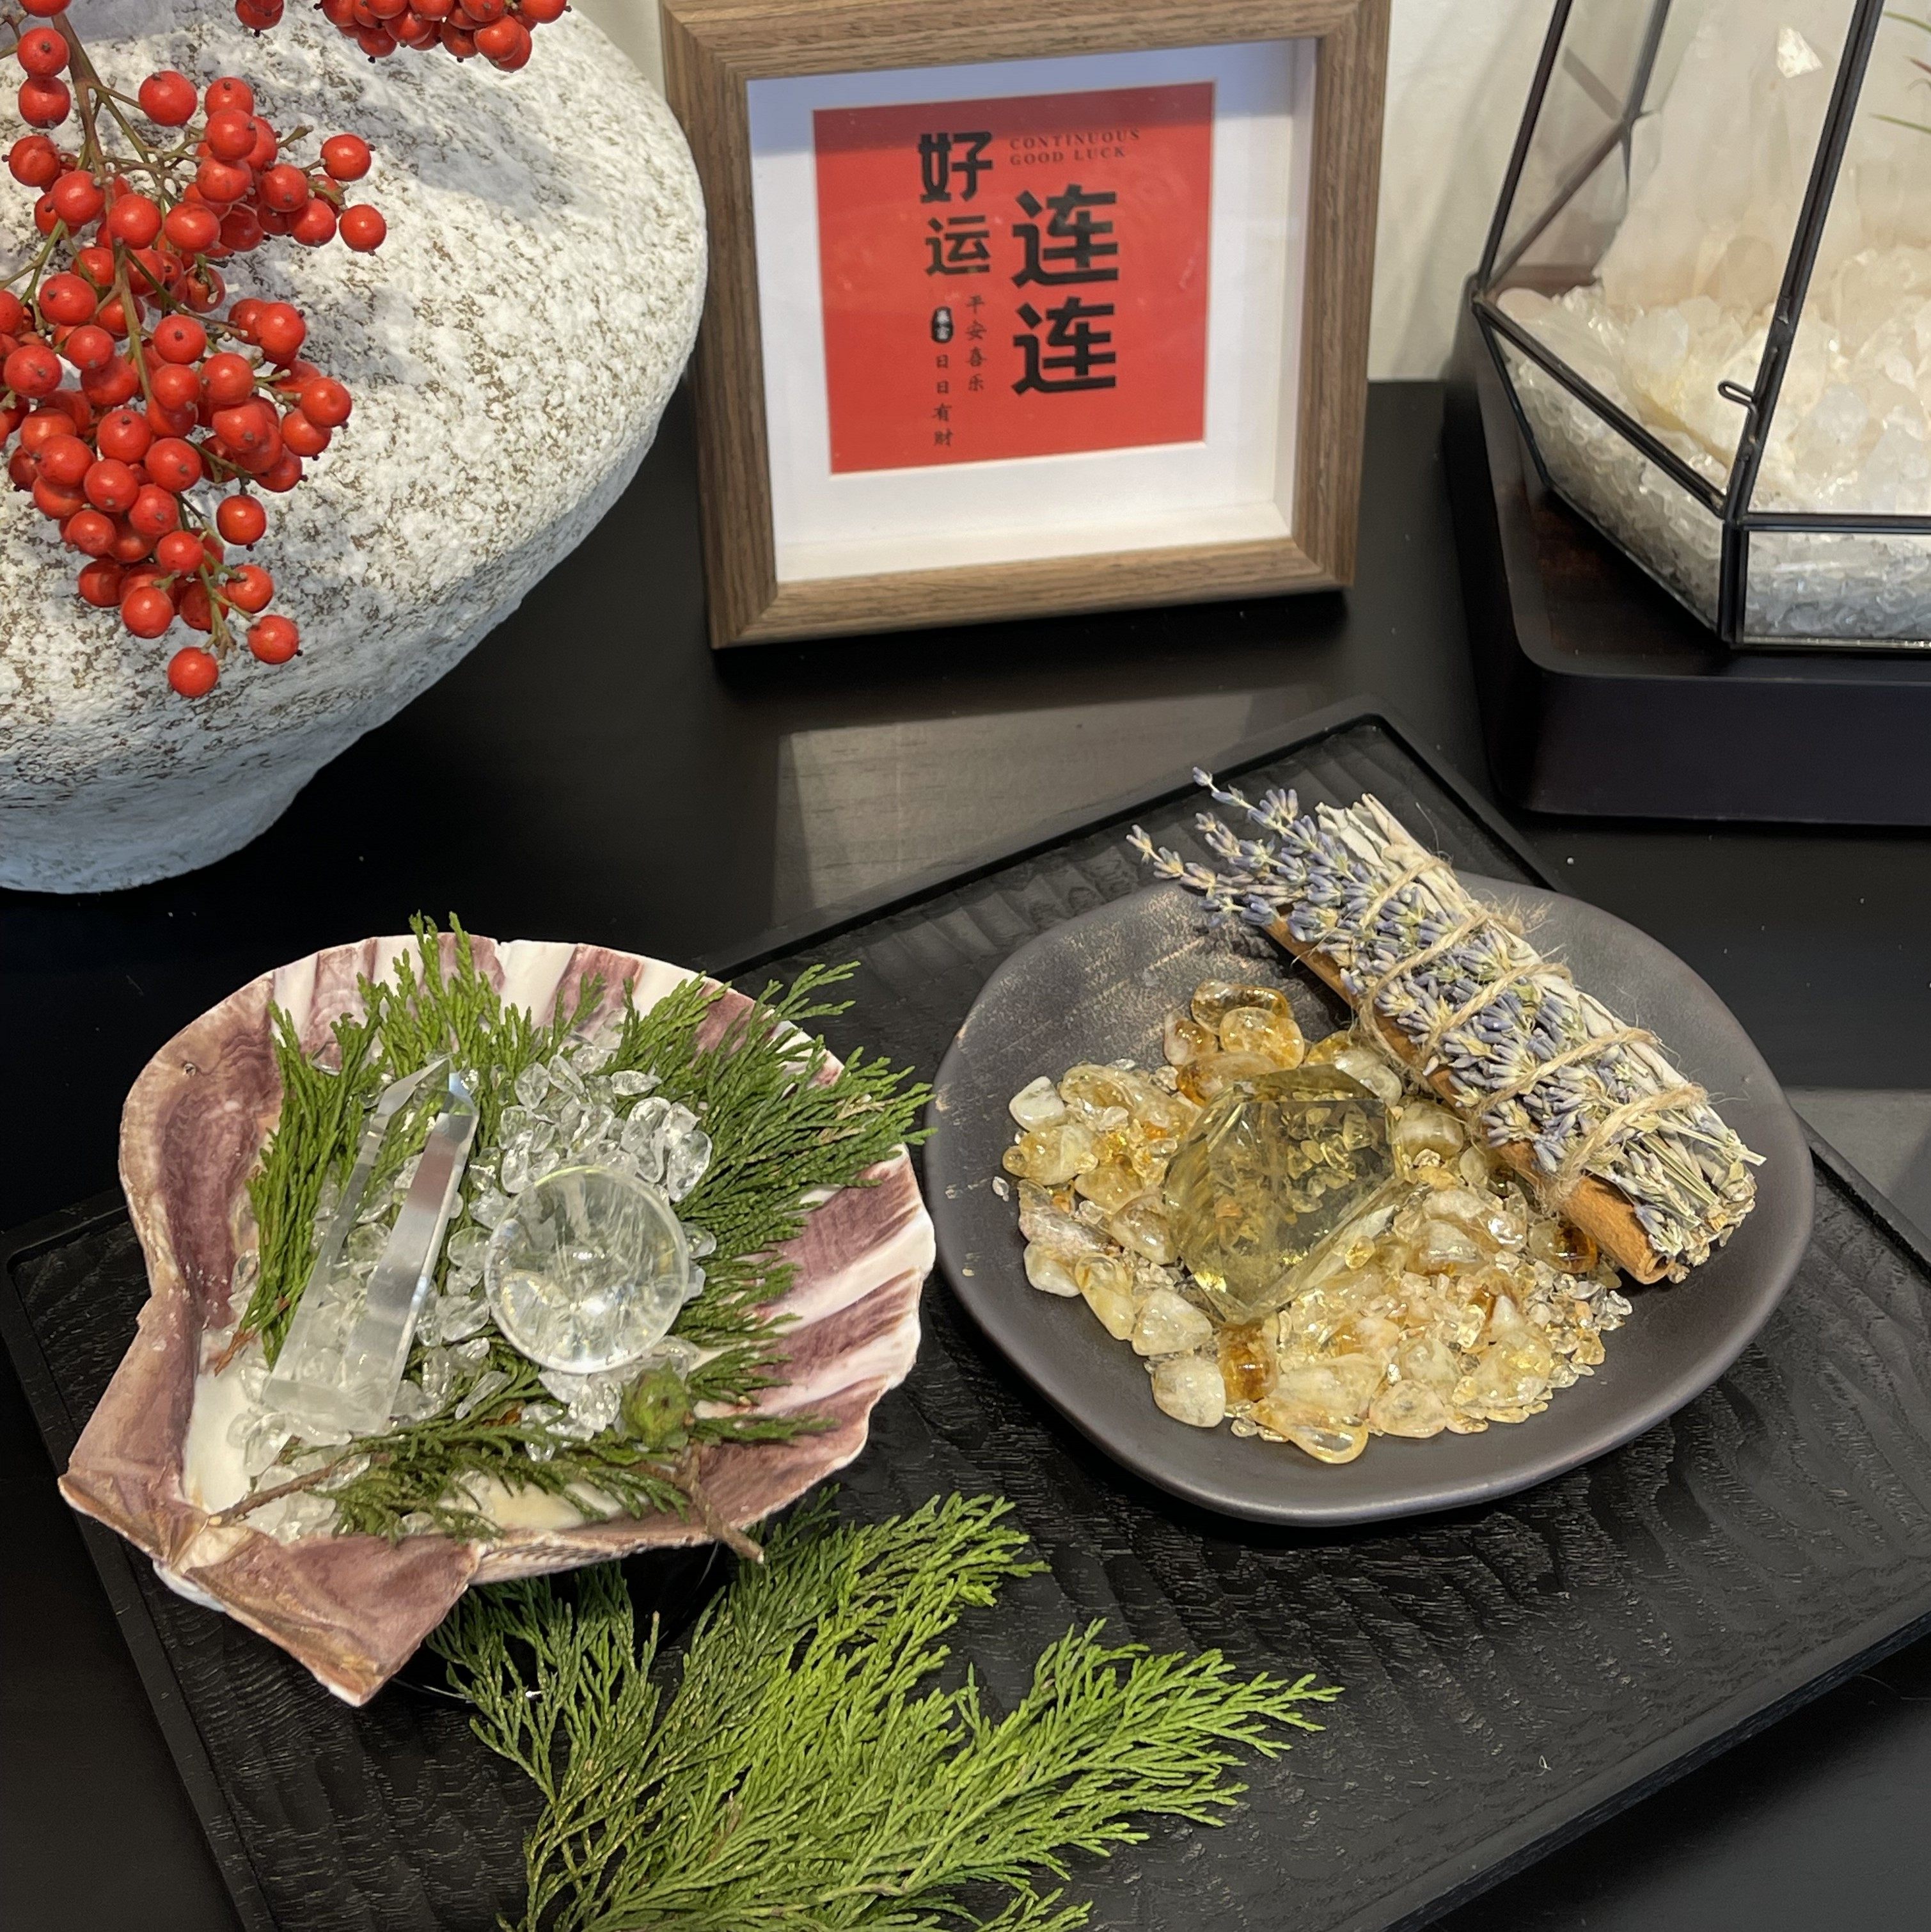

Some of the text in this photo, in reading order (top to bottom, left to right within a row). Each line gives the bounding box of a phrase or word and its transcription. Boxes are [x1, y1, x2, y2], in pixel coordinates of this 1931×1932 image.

[1009, 129, 1140, 150] CONTINUOUS
[1010, 146, 1125, 166] GOOD LUCK
[918, 131, 993, 276] 好运
[1011, 184, 1119, 396] 连连
[966, 294, 988, 392] 平安喜乐
